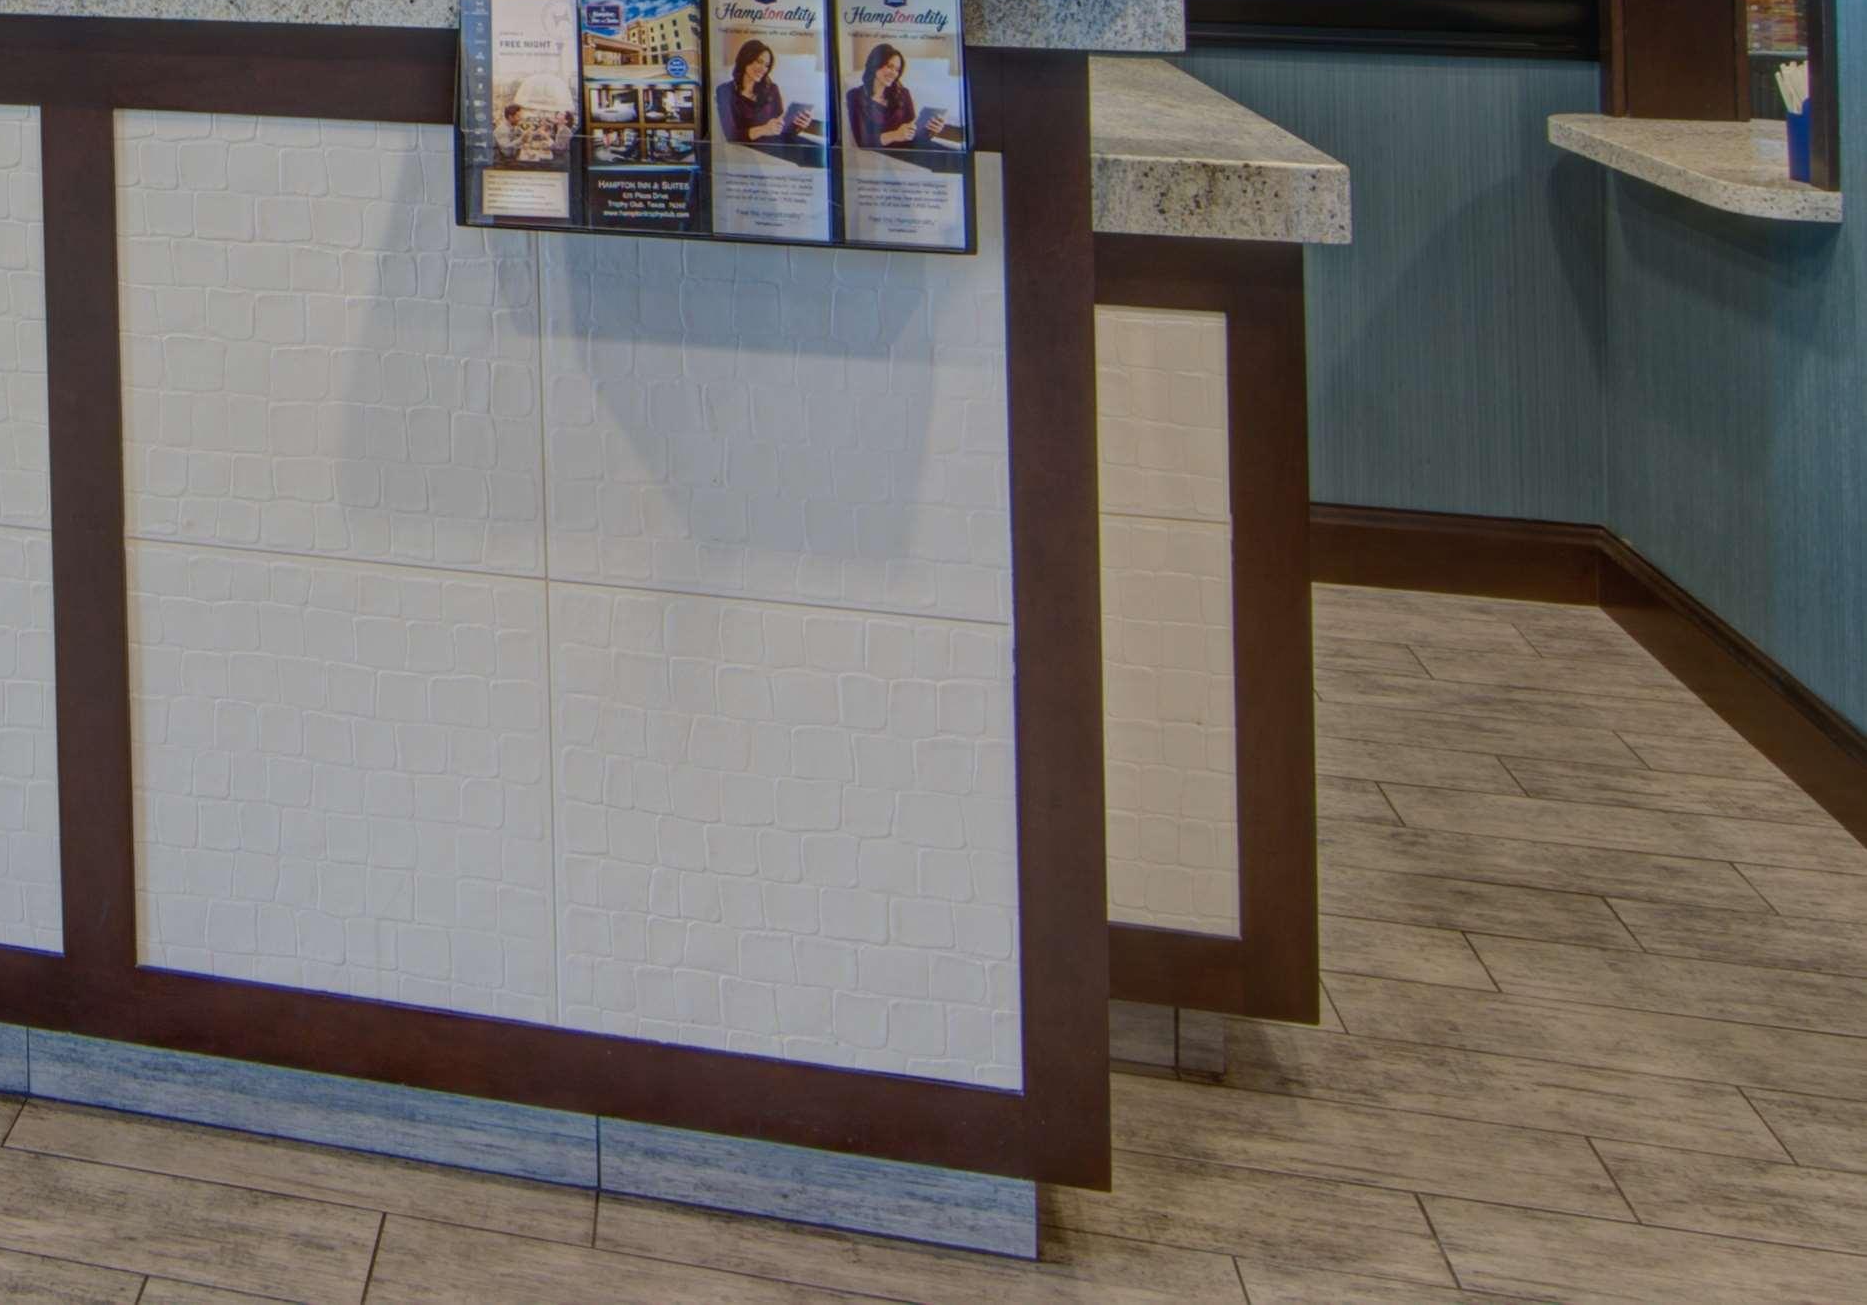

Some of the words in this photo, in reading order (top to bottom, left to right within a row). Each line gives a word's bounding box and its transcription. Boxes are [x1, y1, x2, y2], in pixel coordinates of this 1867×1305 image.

[715, 2, 817, 30] Hamptonality
[844, 6, 949, 32] Hamptonality
[499, 40, 521, 48] FREE
[523, 40, 551, 48] NIGHT
